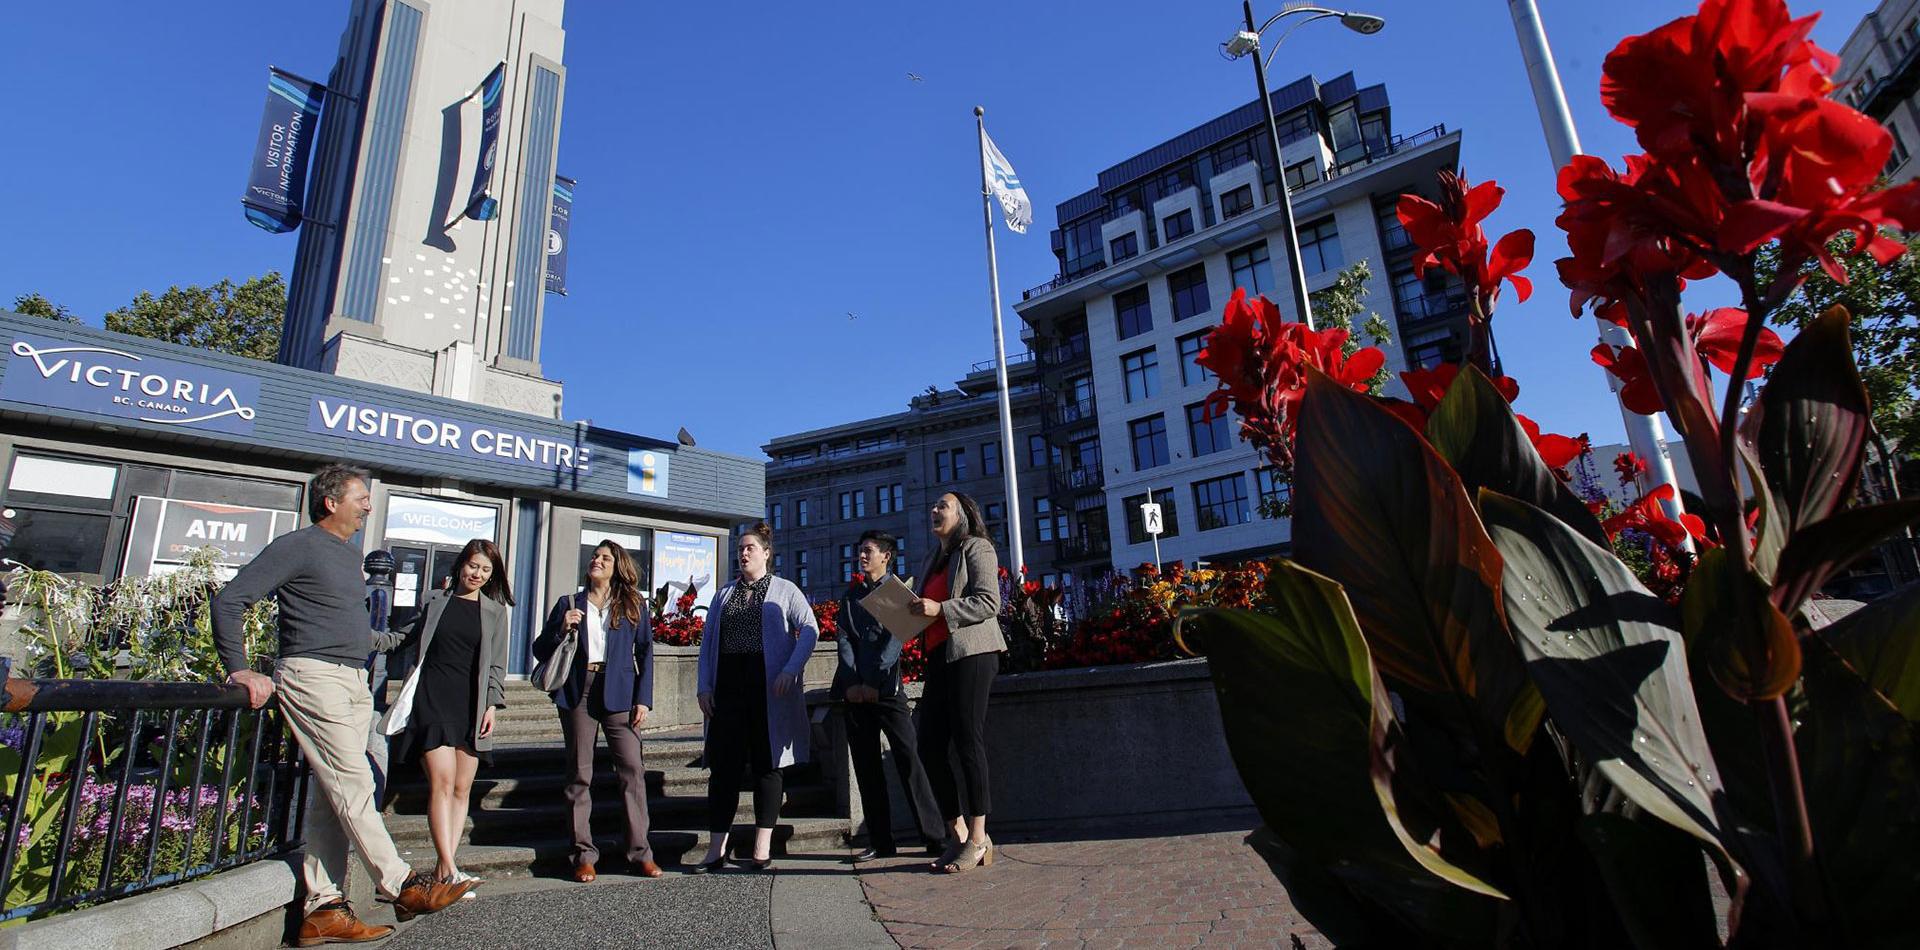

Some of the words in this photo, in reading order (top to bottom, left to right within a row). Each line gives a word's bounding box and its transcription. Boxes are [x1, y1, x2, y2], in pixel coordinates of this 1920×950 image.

[266, 124, 285, 169] VISITOR
[280, 111, 303, 191] INFORMATION
[251, 186, 298, 206] VICTORIA
[12, 341, 256, 423] VICTORIA
[138, 400, 188, 414] CANADA
[316, 400, 461, 450] VISITOR
[470, 429, 590, 470] CENTRE
[185, 519, 249, 543] ATM
[403, 513, 484, 533] WELCOME
